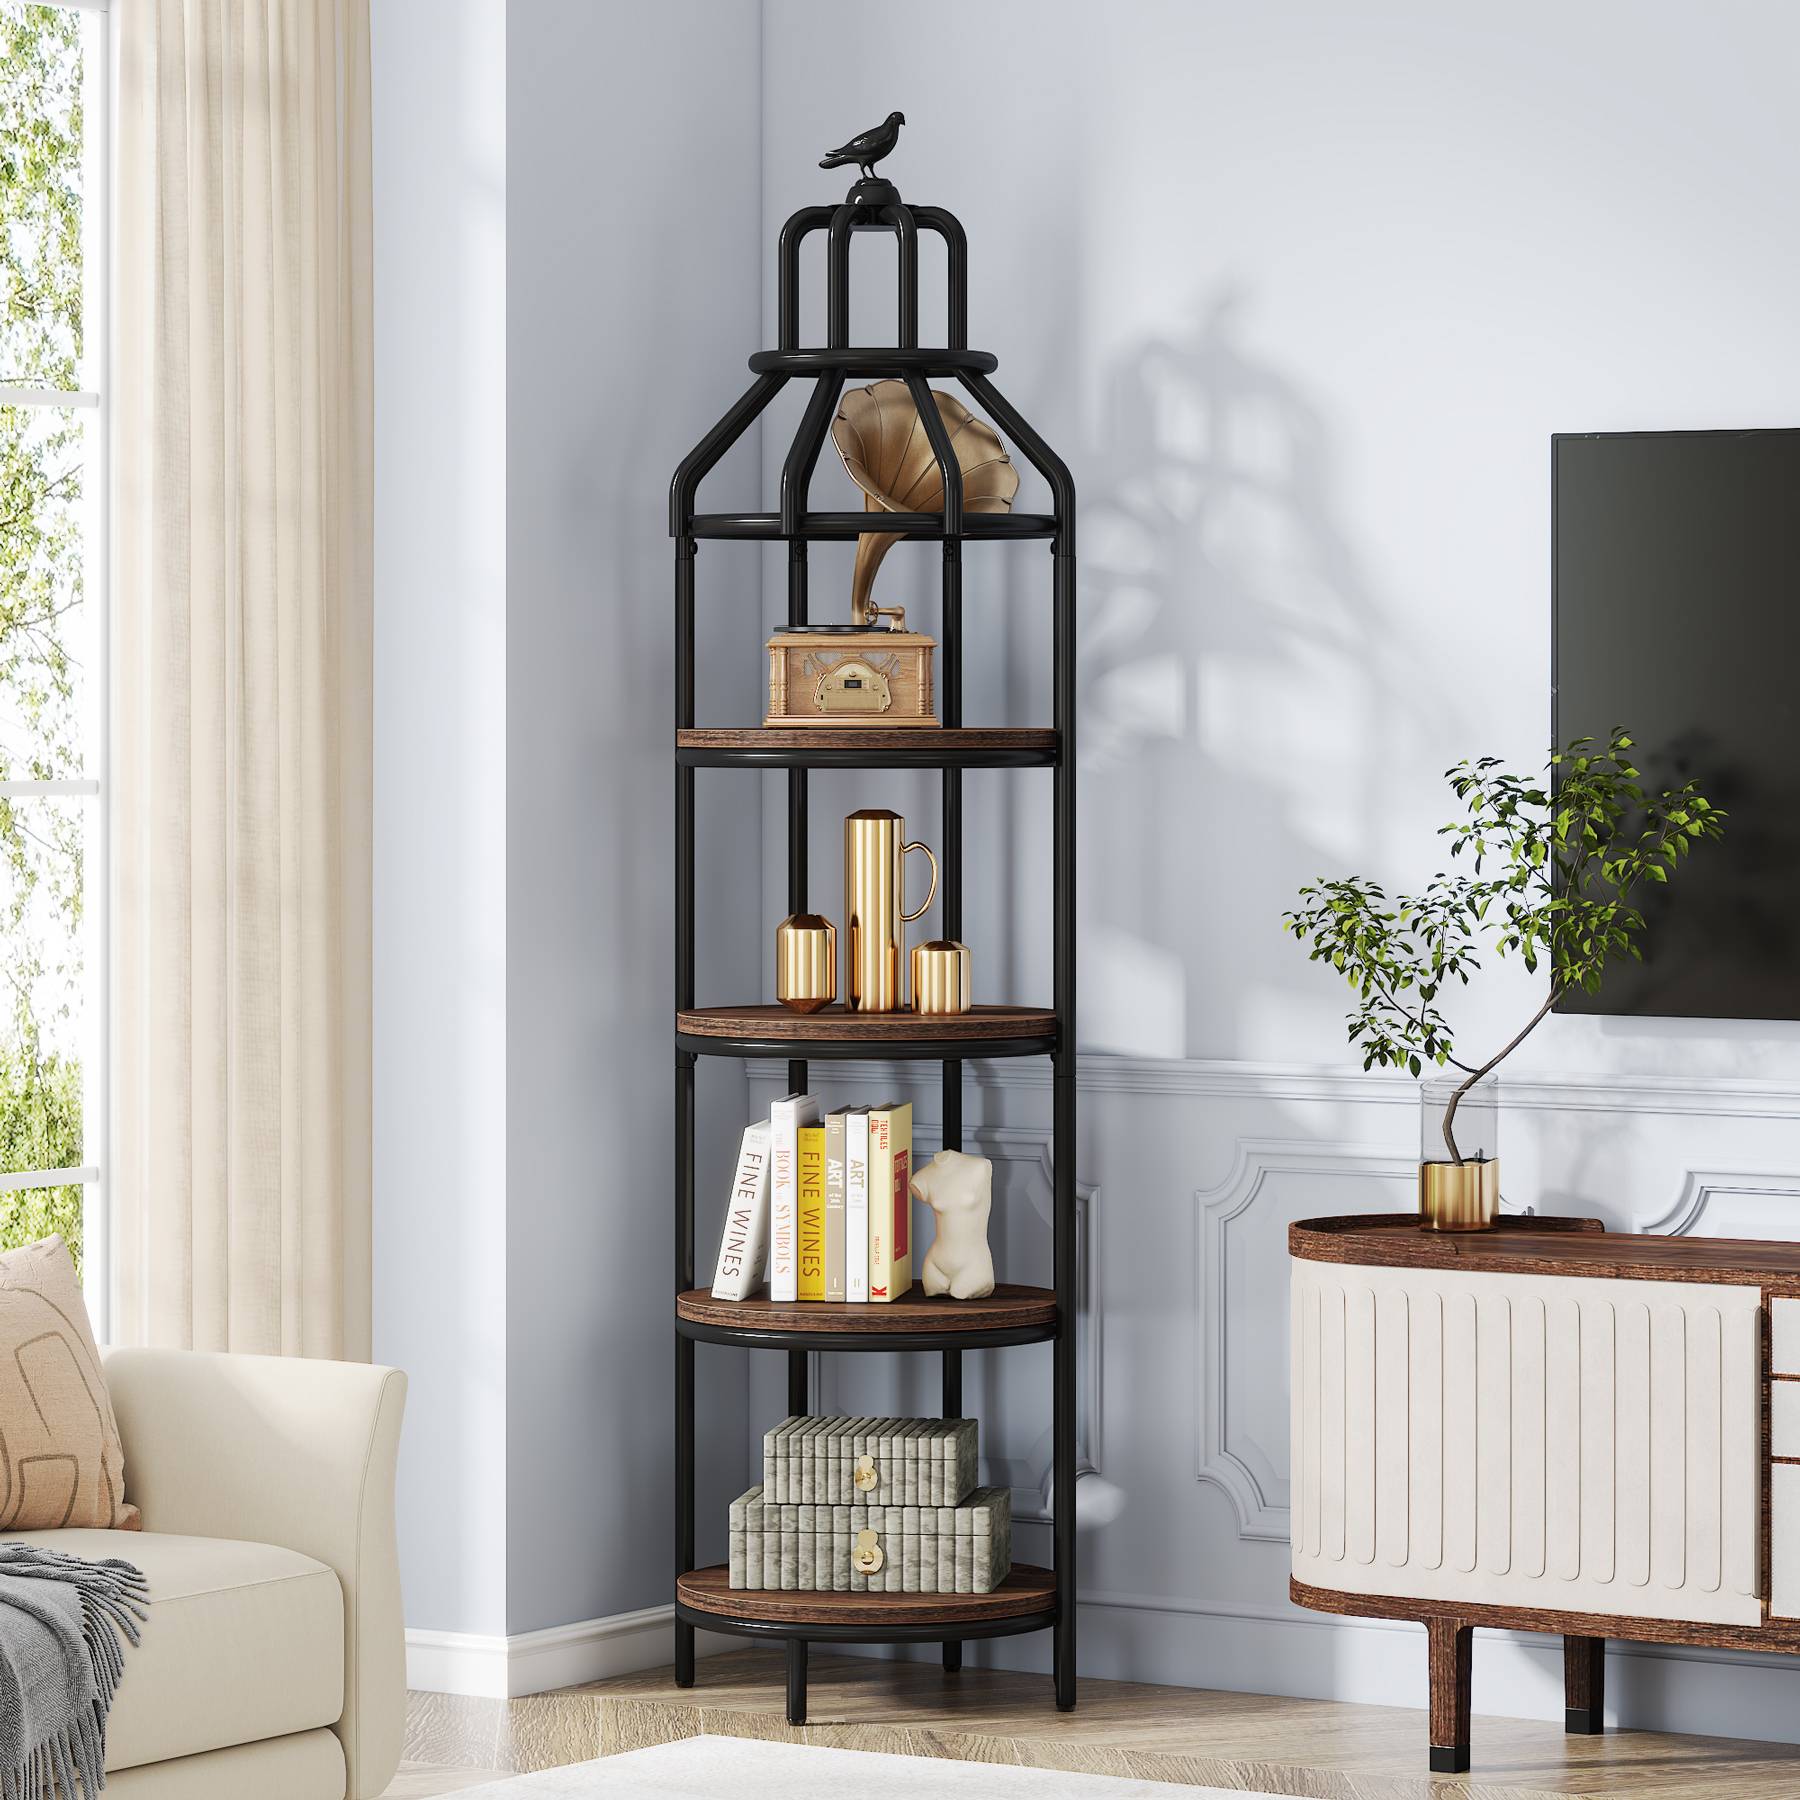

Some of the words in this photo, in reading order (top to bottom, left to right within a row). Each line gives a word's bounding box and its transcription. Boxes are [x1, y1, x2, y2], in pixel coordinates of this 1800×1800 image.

[879, 1119, 888, 1150] TEXTILES
[738, 1152, 762, 1200] FINE
[775, 1150, 791, 1188] BOOK
[802, 1151, 820, 1198] FINE
[827, 1158, 843, 1189] ART
[850, 1159, 865, 1189] ART
[722, 1209, 752, 1277] WINES
[775, 1204, 791, 1274] SYMBOLS
[802, 1208, 820, 1278] WINES
